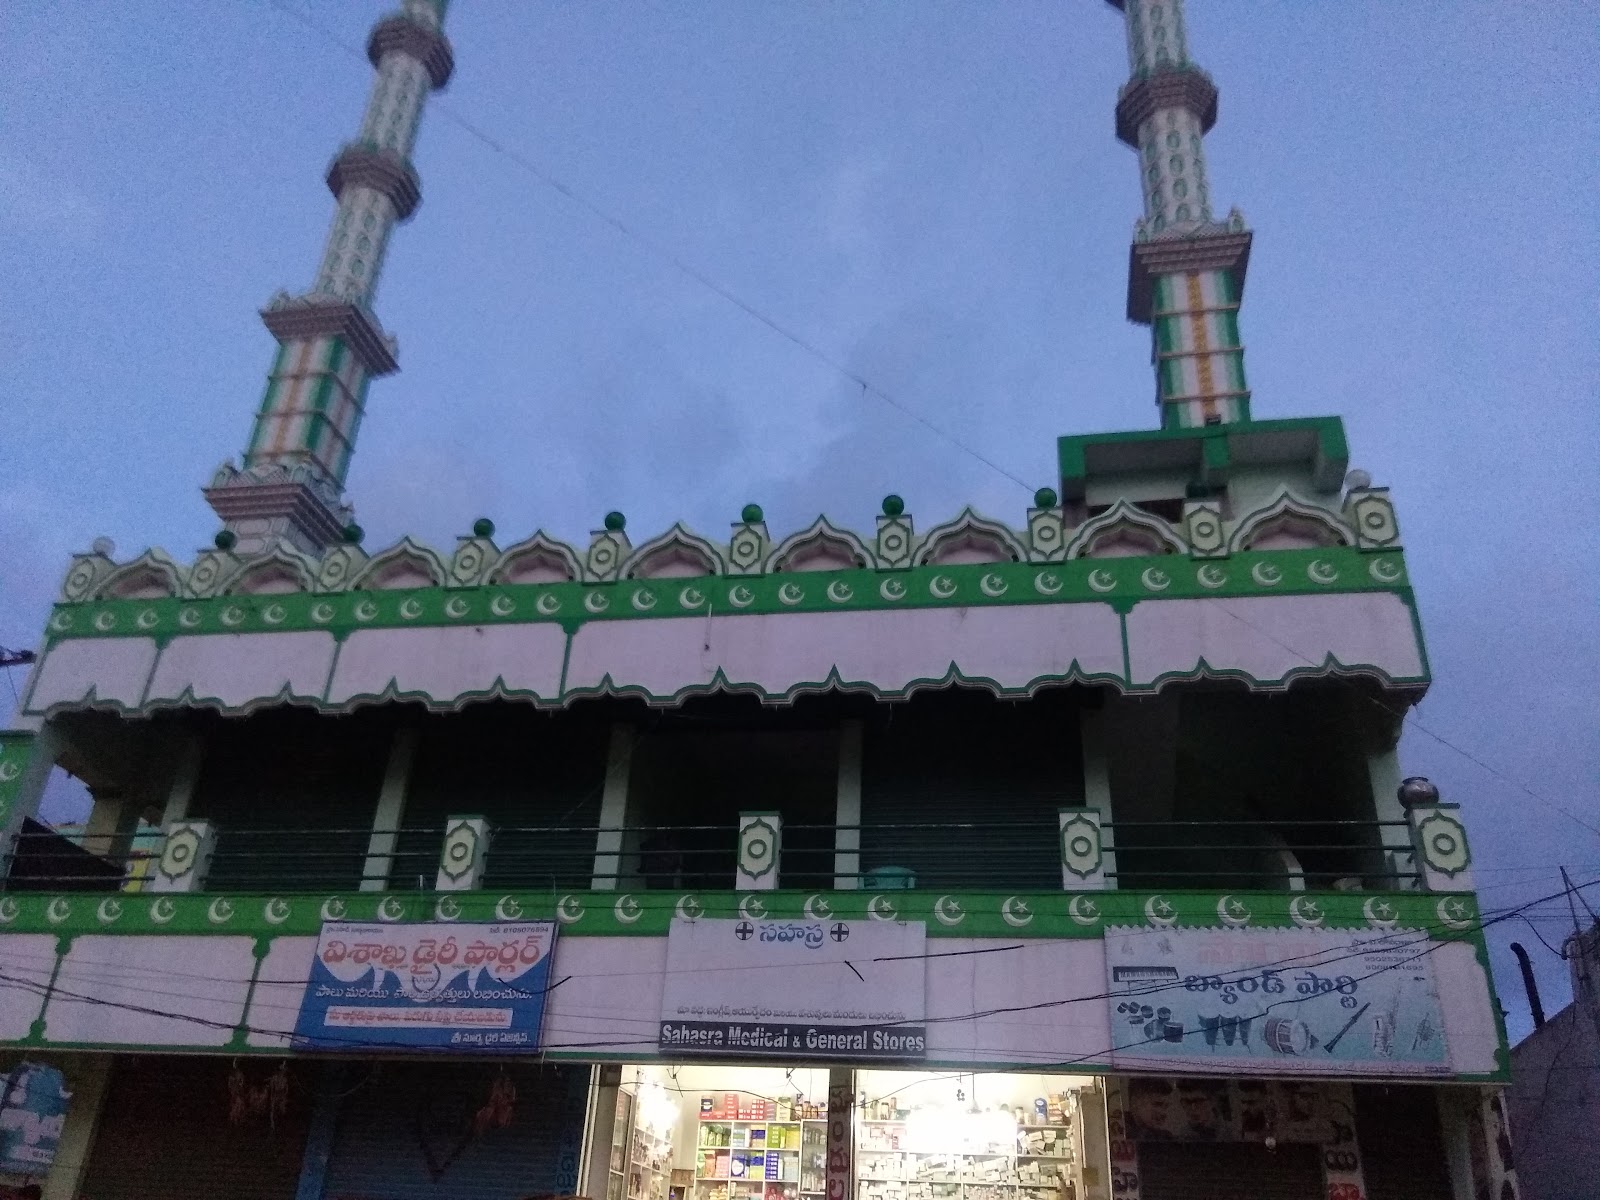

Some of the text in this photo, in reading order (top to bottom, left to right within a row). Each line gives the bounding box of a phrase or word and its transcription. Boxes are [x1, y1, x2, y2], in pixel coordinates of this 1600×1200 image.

[323, 935, 543, 975] విశాఖ డైరీ పార్లర్
[315, 985, 344, 998] పాలు
[345, 986, 389, 999] మరియు
[1185, 969, 1286, 1005] బ్యాండ్
[661, 1024, 925, 1051] Sahasra Medical & General Stores
